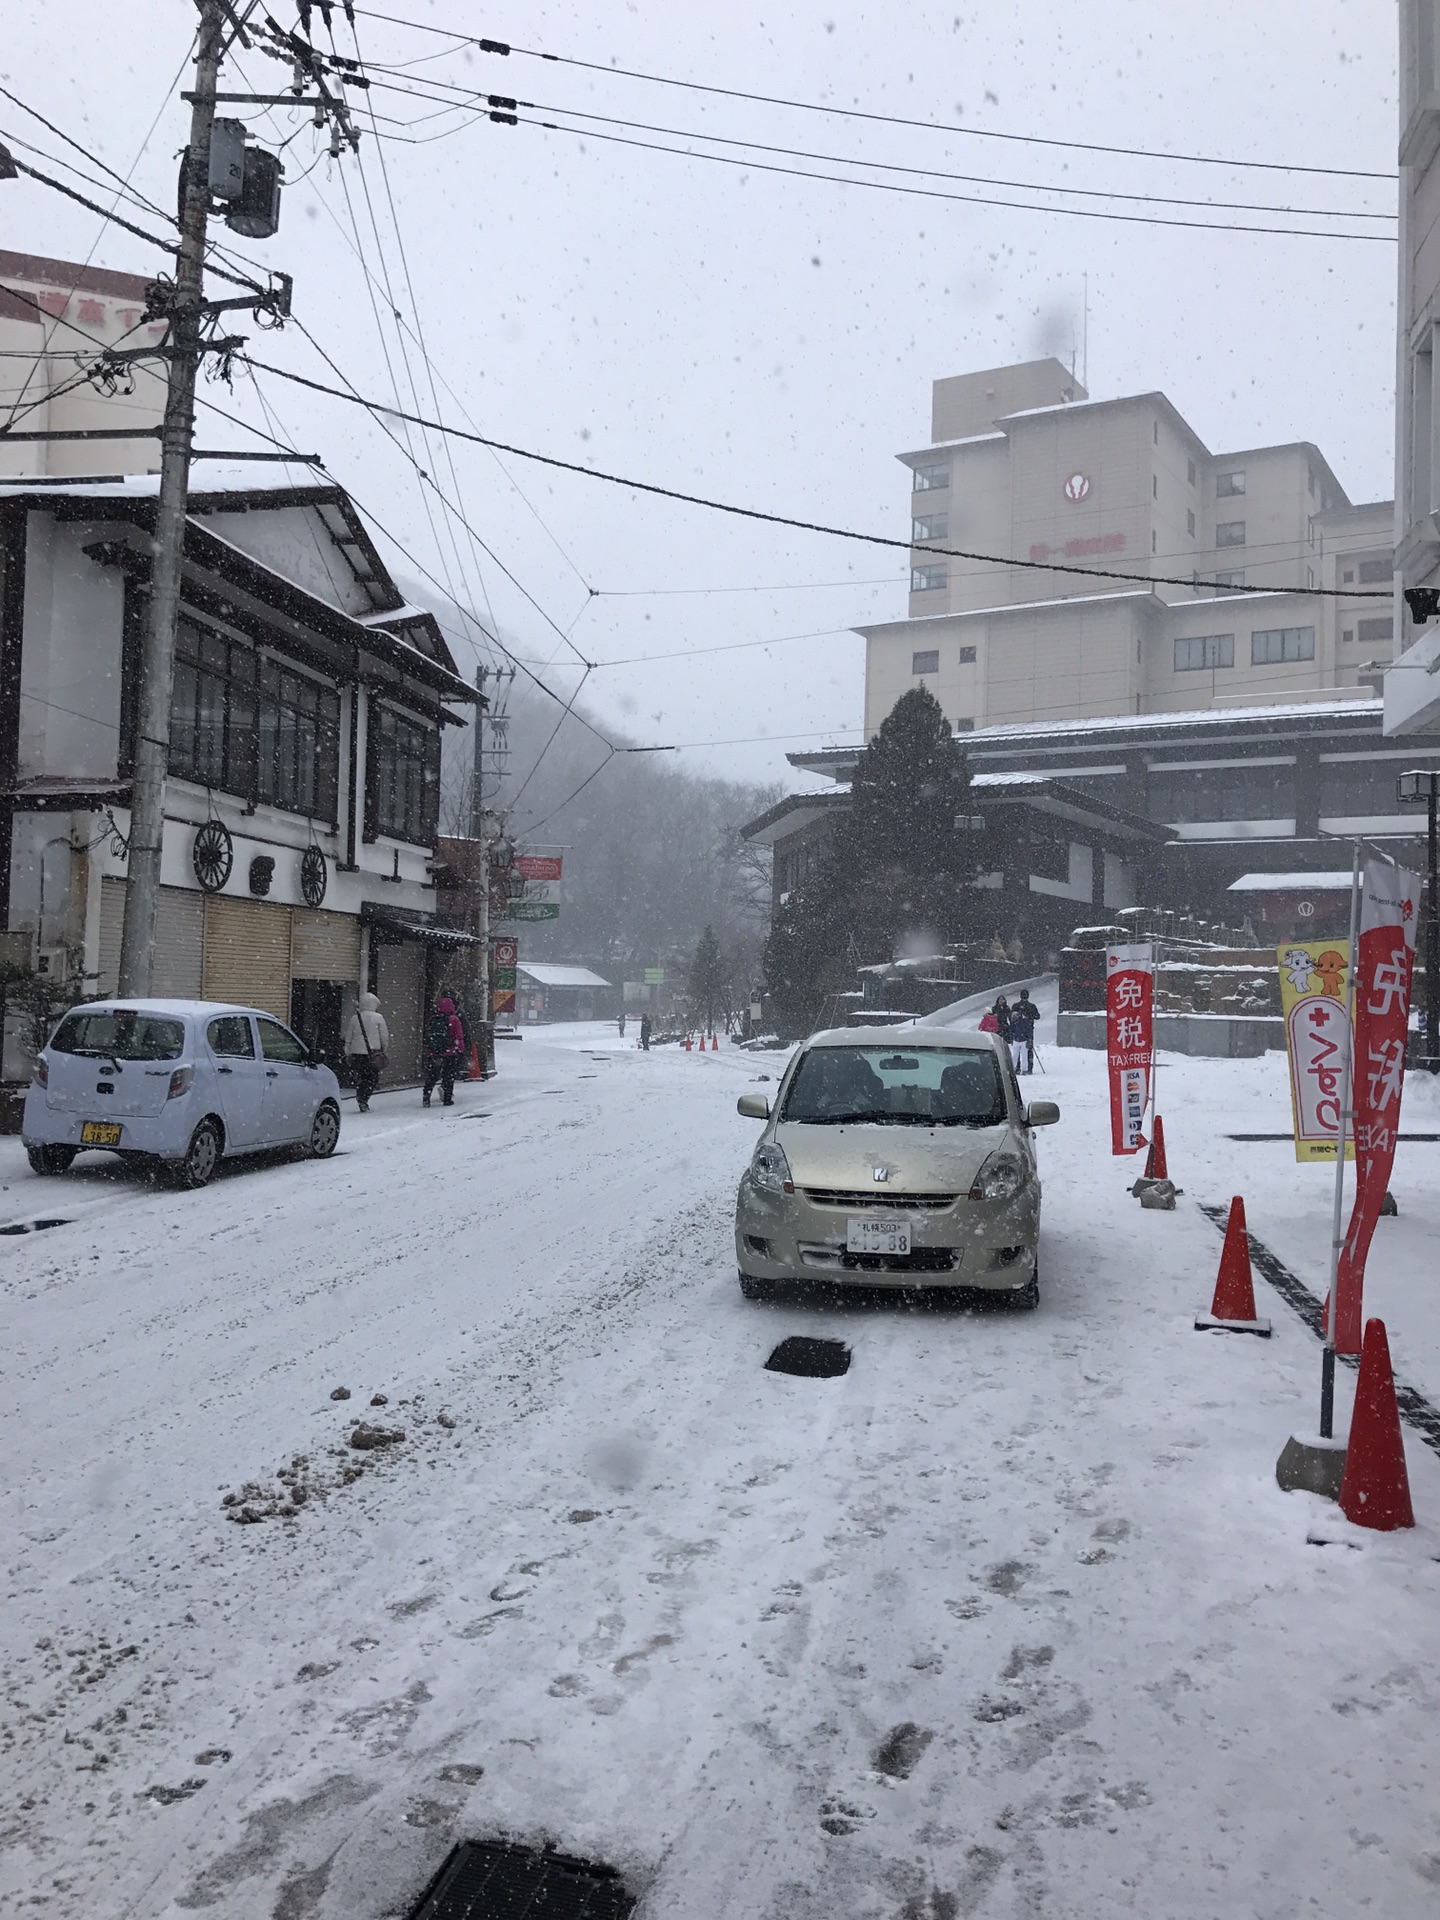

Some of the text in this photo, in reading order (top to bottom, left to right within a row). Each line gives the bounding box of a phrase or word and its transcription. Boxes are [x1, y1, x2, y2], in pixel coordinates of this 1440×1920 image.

[228, 163, 242, 180] 20
[1115, 977, 1146, 1049] 免税
[1110, 1052, 1151, 1067] TAX-FREE
[90, 1130, 118, 1144] 38-50
